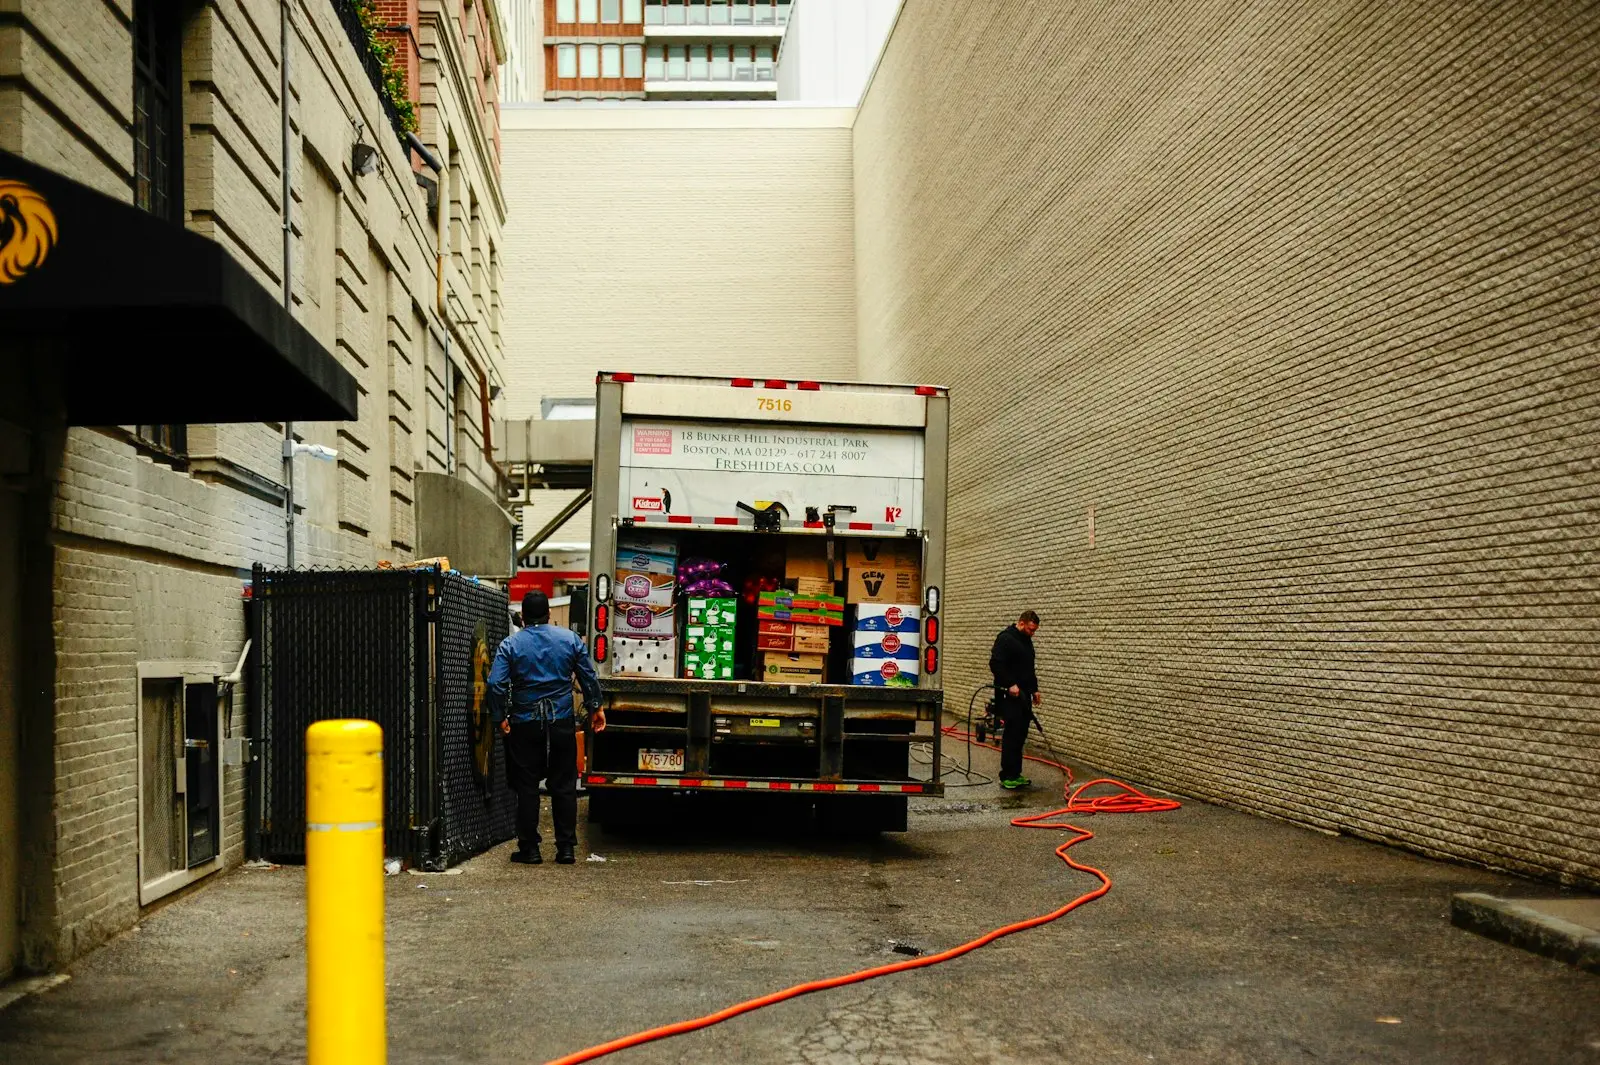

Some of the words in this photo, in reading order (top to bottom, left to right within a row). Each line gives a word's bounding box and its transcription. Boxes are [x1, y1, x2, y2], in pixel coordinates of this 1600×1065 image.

[757, 398, 792, 412] 7516
[681, 431, 693, 440] 18
[697, 432, 740, 442] BUNKER
[744, 434, 770, 444] HILL
[773, 435, 838, 447] INDUSTRIAL
[842, 438, 869, 448] PARK
[734, 447, 752, 456] MA
[755, 447, 787, 457] 02129
[797, 450, 816, 459] 617
[819, 450, 837, 460] 241
[841, 451, 866, 461] 8007
[715, 457, 836, 473] FRESHIDEAS.COM
[635, 499, 661, 509] Kidron
[861, 571, 885, 580] GEN
[863, 580, 883, 597] V
